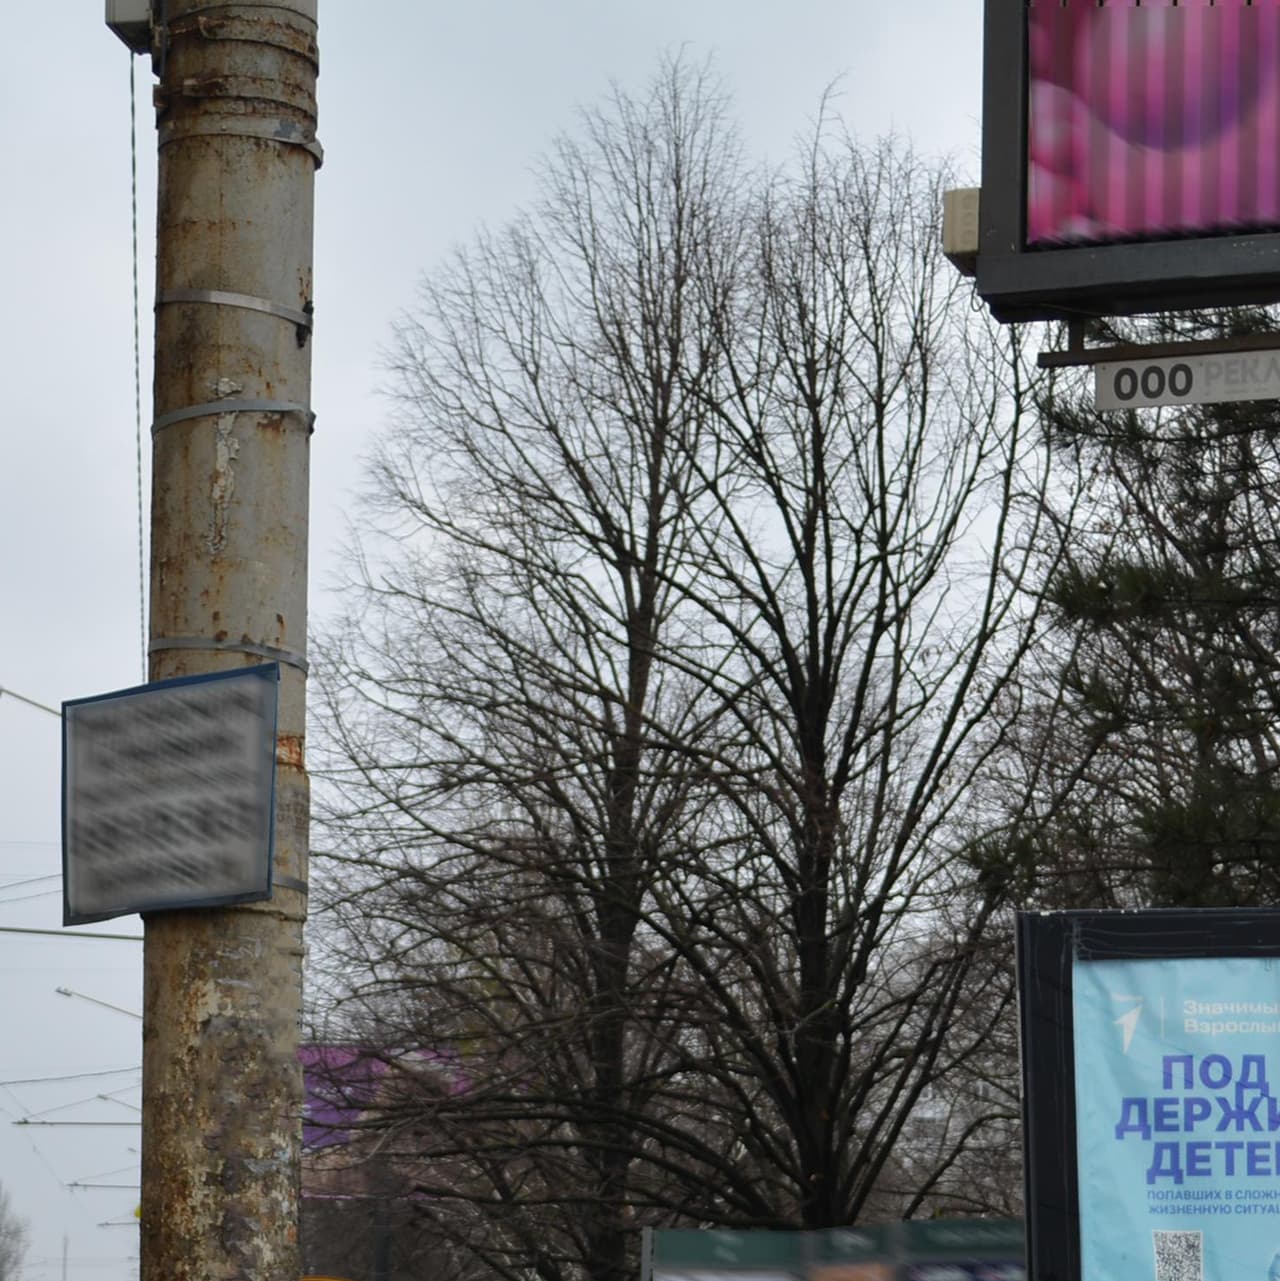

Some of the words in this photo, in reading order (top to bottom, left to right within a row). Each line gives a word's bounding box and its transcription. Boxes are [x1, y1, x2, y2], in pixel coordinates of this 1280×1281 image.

[1162, 1053, 1269, 1101] ПОД
[1147, 1189, 1221, 1201] ПОПАВШИХ
[1224, 1189, 1233, 1201] В
[1149, 1204, 1232, 1215] ЖИЗНЕННУЮ
